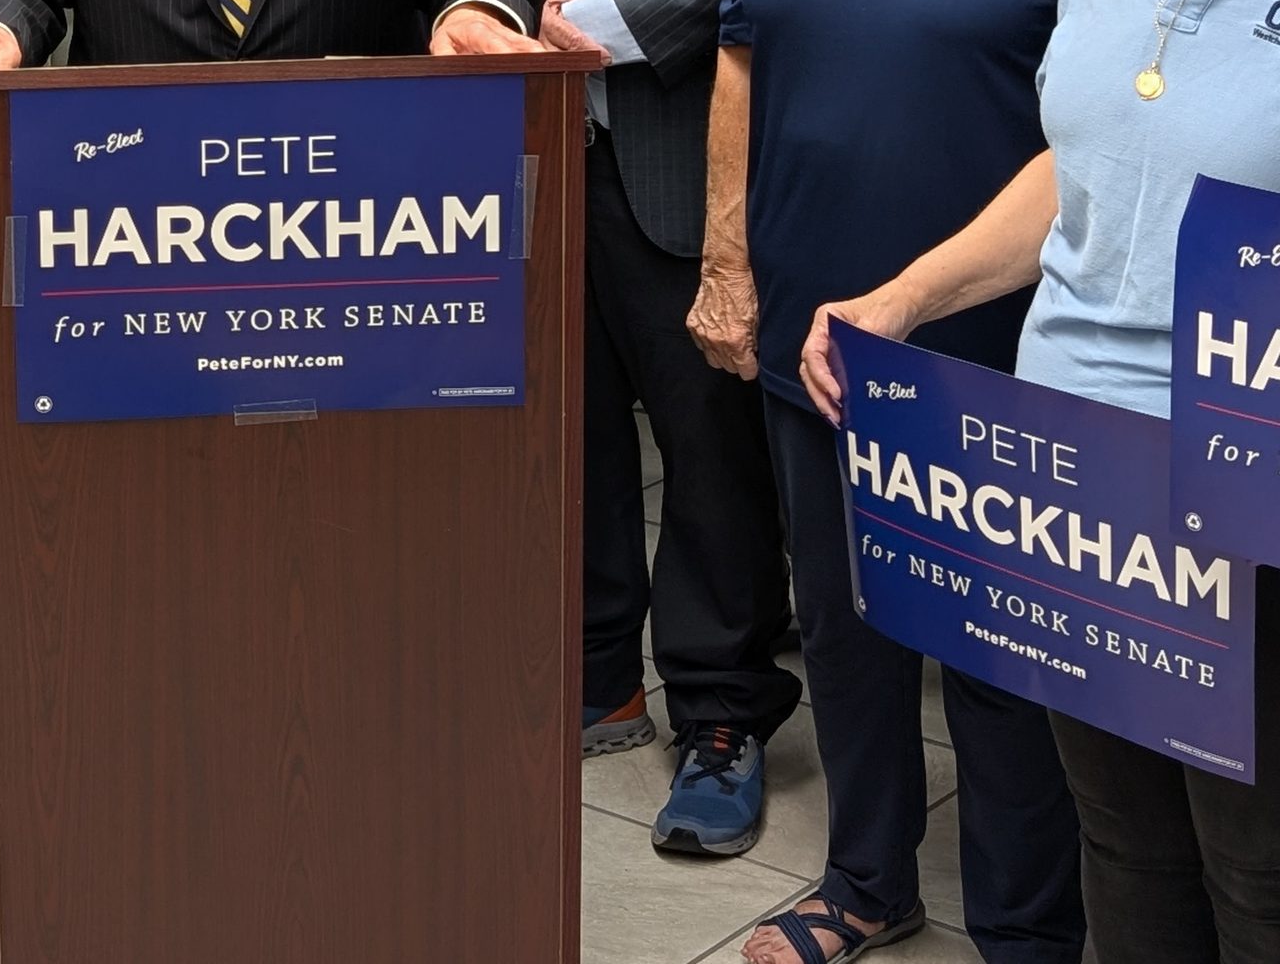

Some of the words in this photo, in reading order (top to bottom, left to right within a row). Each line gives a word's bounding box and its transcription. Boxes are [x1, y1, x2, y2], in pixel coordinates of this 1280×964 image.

[74, 129, 143, 162] Re-Elect
[201, 136, 336, 176] PETE
[39, 195, 499, 267] HARCKHAM
[55, 316, 104, 342] for
[125, 312, 206, 334] NEW
[226, 308, 325, 331] YORK
[345, 302, 485, 327] SENATE
[198, 355, 343, 370] PeteForNY.com
[867, 381, 917, 399] Re-Elect
[962, 415, 1077, 485] PETE
[1208, 435, 1259, 465] for
[847, 430, 1231, 620] HARCKHAM
[863, 535, 896, 563] for
[909, 555, 971, 596] NEW
[986, 586, 1069, 635] YORK
[1086, 625, 1214, 687] SENATE
[965, 620, 1086, 679] PeteForNY.com
